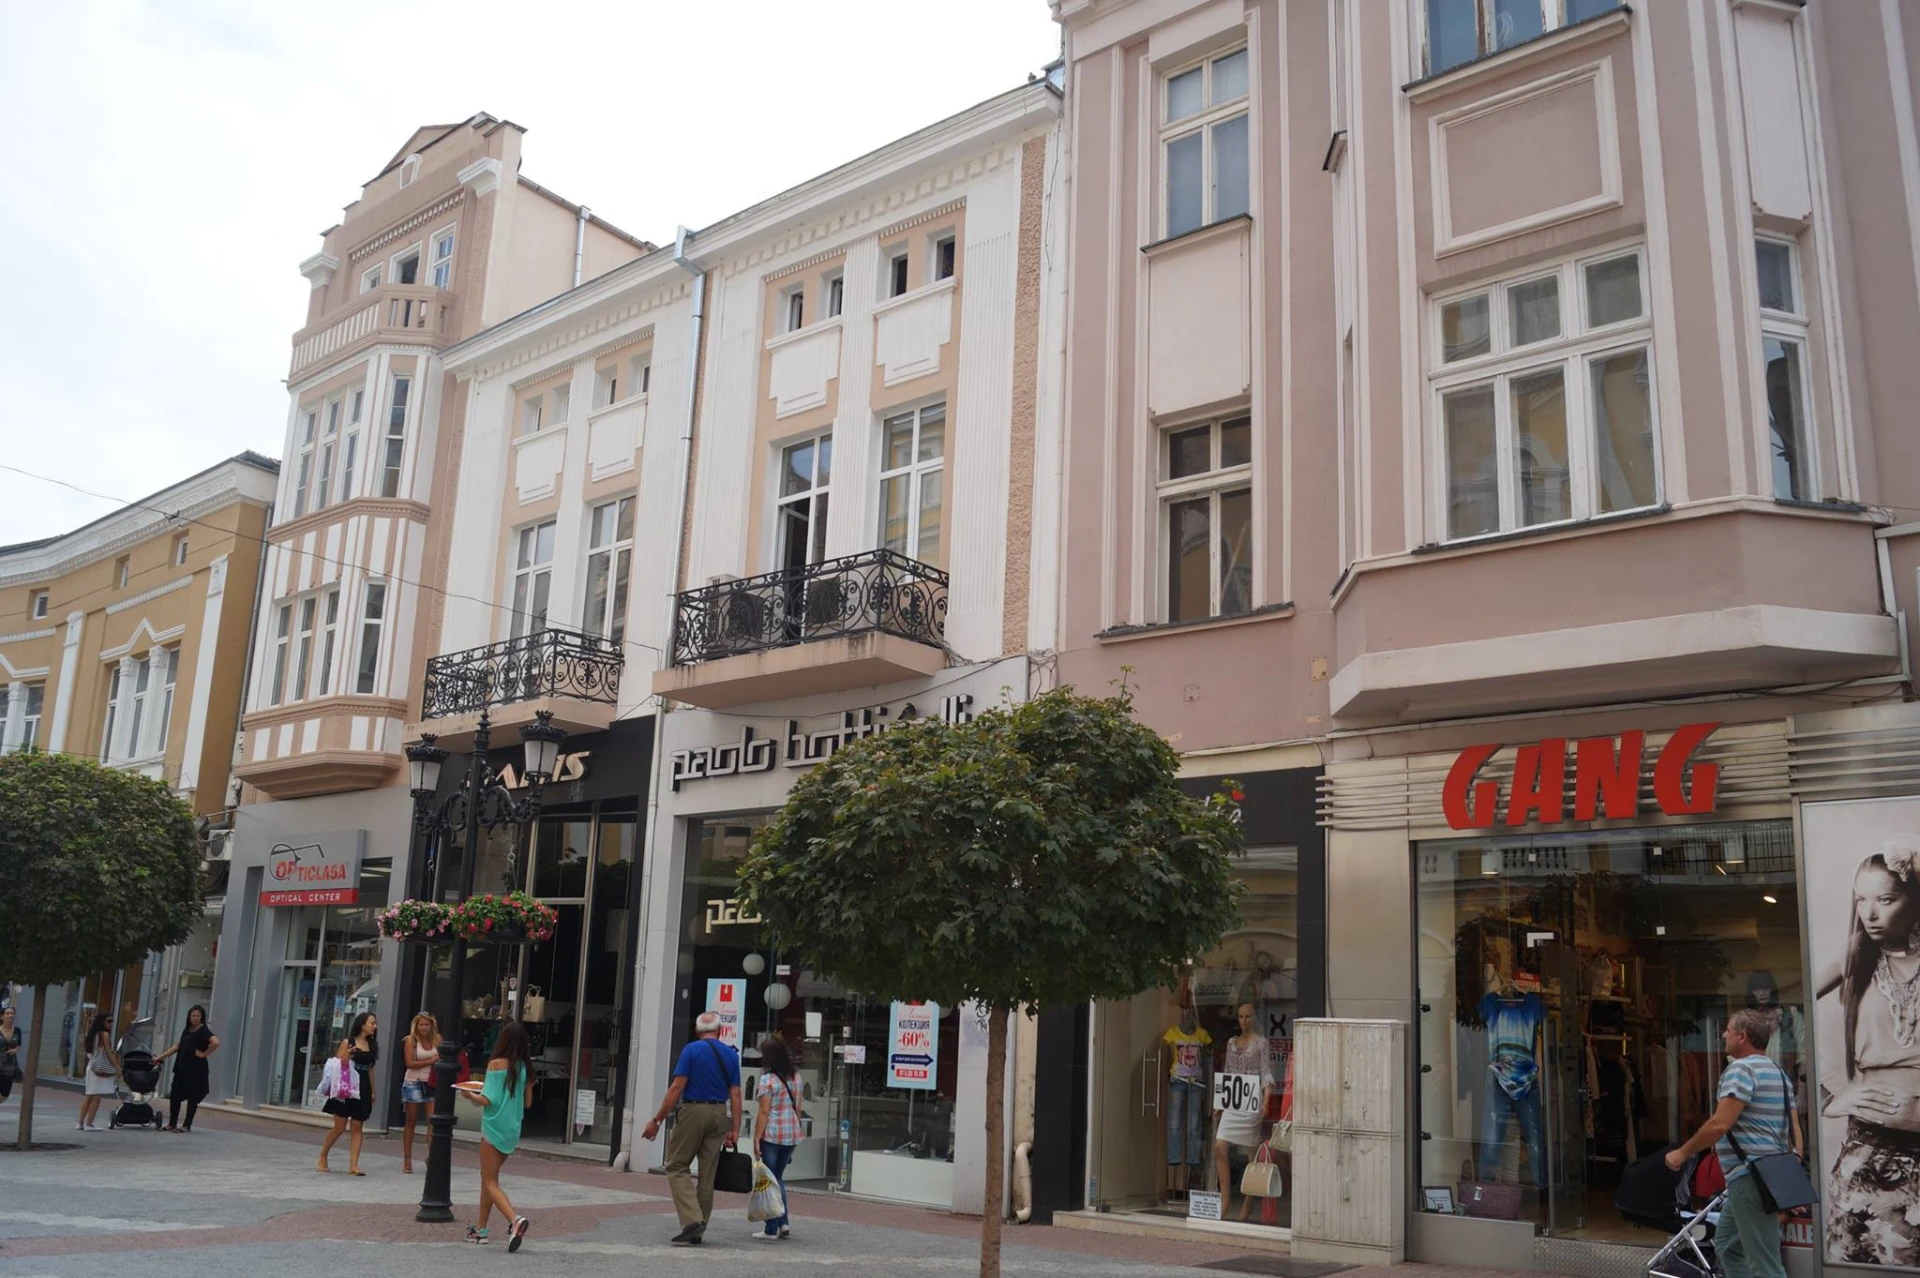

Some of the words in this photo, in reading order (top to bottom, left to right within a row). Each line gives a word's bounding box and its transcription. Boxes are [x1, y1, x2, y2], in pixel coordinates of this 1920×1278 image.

[781, 695, 971, 768] bottilli
[1442, 722, 1723, 830] GANG
[269, 894, 302, 903] OPTICAL
[308, 892, 341, 901] CENTER
[898, 1032, 930, 1048] -60%
